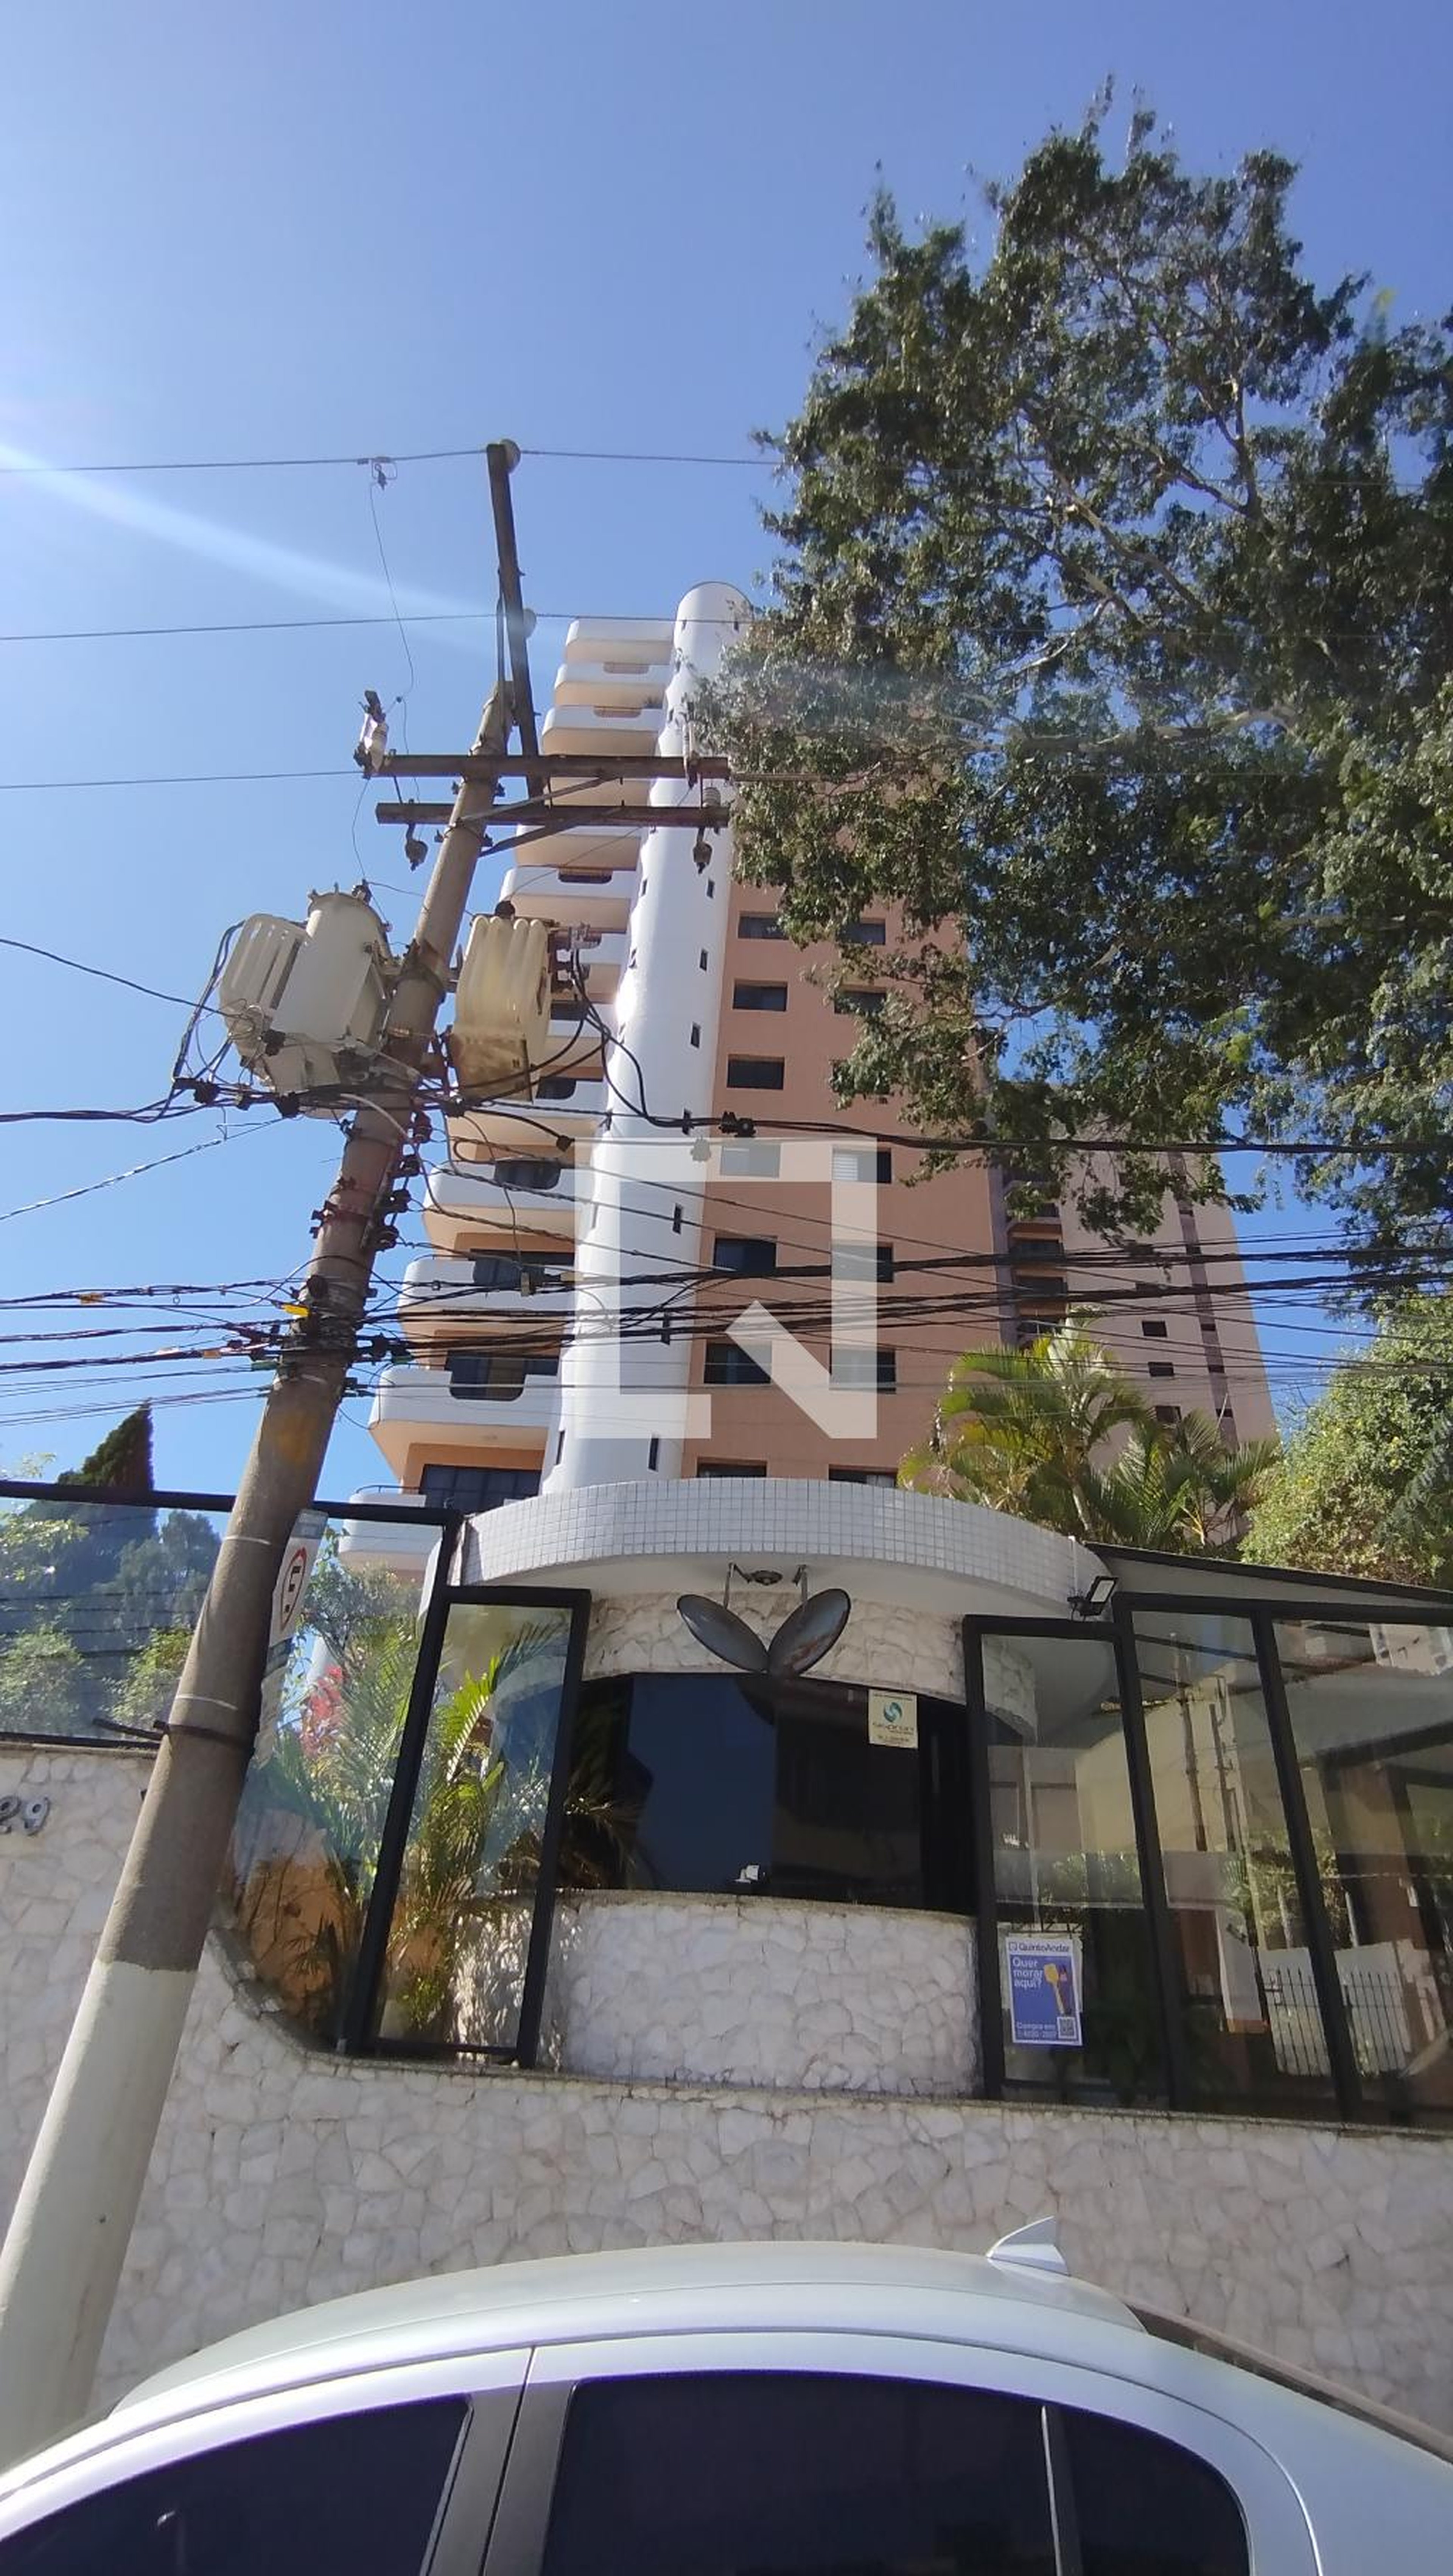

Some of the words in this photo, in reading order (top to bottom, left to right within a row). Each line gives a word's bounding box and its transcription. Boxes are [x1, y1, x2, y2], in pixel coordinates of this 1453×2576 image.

[1019, 1942, 1069, 1952] QuintoAndar
[1012, 1956, 1038, 1968] Quer
[1013, 1969, 1043, 1978] morar
[1014, 1978, 1042, 1990] aqui?
